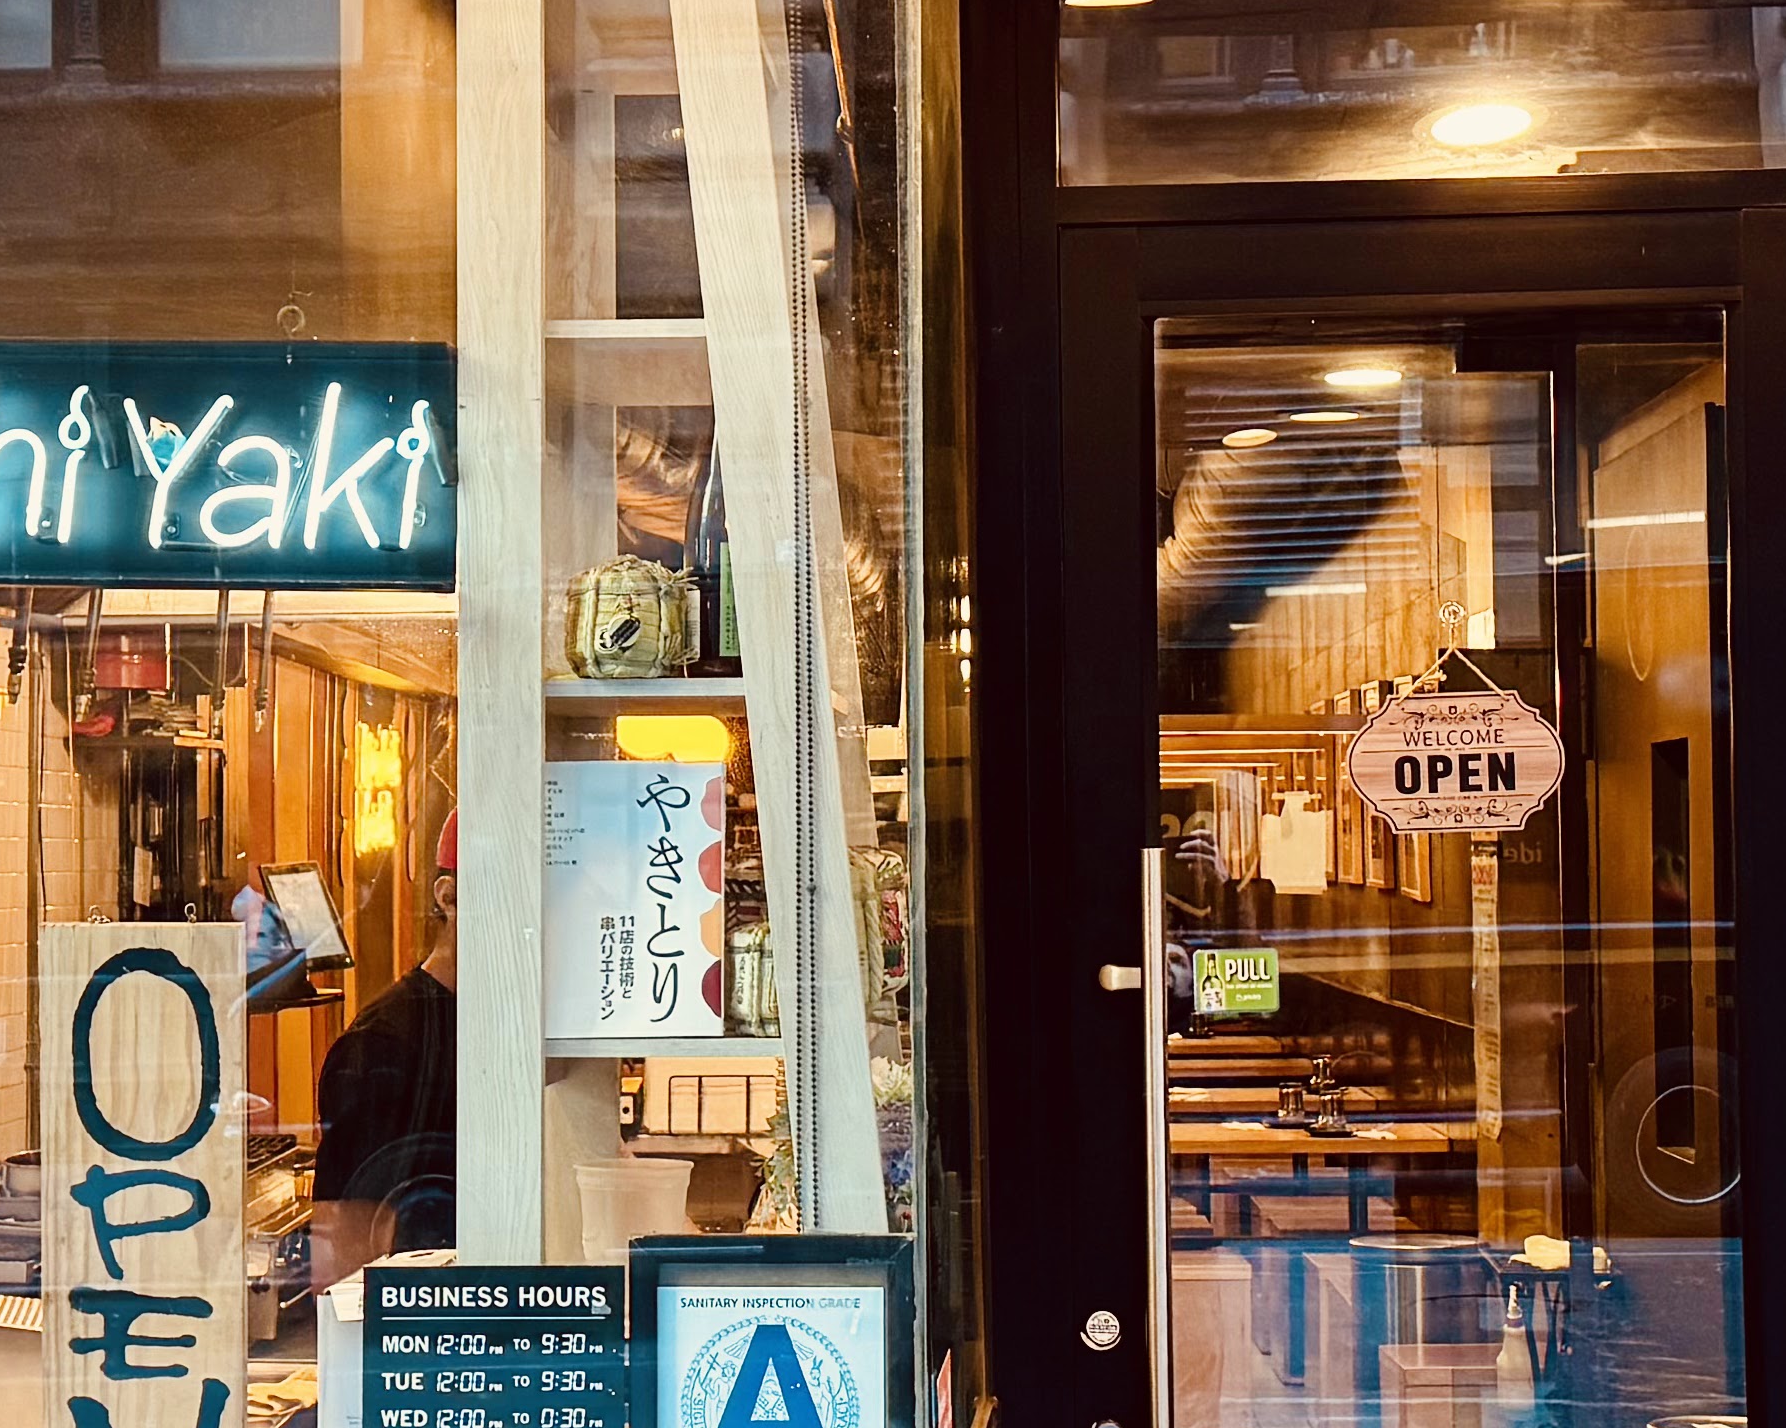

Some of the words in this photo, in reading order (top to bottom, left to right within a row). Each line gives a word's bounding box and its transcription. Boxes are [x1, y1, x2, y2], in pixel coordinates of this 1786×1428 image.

[122, 380, 429, 551] Yaki
[1402, 728, 1505, 747] WELCOME
[1394, 751, 1516, 794] OPEN
[636, 773, 691, 1023] やきとり
[600, 916, 616, 1021] 串バリエーション
[1225, 957, 1271, 982] PULL
[381, 1286, 509, 1308] BUSINESS
[518, 1286, 608, 1309] HOURS
[680, 1297, 739, 1309] SANITARY
[742, 1297, 814, 1310] INSPECTION
[818, 1297, 861, 1309] GRADE
[382, 1335, 430, 1353] MON
[436, 1334, 486, 1355] 12:00
[513, 1338, 531, 1351] TO
[541, 1334, 586, 1354] 9:30
[381, 1372, 424, 1391] TUE
[436, 1371, 485, 1392] 12:00
[512, 1375, 530, 1388] TO
[541, 1371, 586, 1392] 9:30
[380, 1409, 428, 1427] WED
[436, 1409, 485, 1428] 12:00
[512, 1412, 530, 1424] TO
